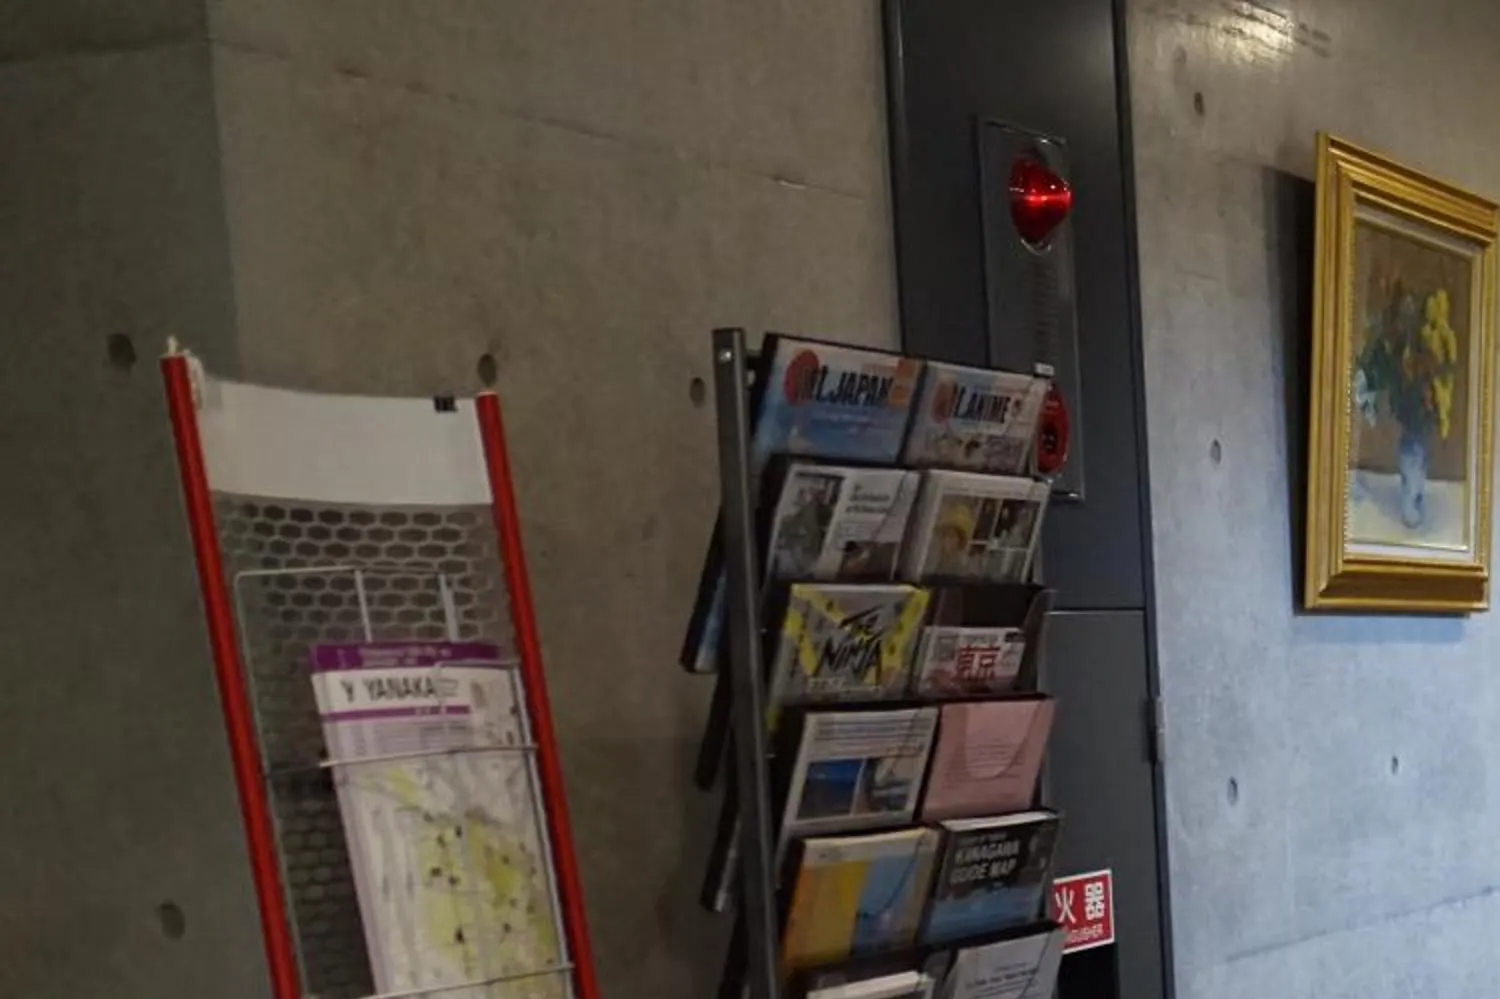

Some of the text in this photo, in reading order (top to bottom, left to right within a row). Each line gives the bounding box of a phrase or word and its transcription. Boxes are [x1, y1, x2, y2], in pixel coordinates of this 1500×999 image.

[956, 644, 1001, 681] 東京
[362, 677, 437, 701] YANAKA
[990, 858, 1018, 878] MAP
